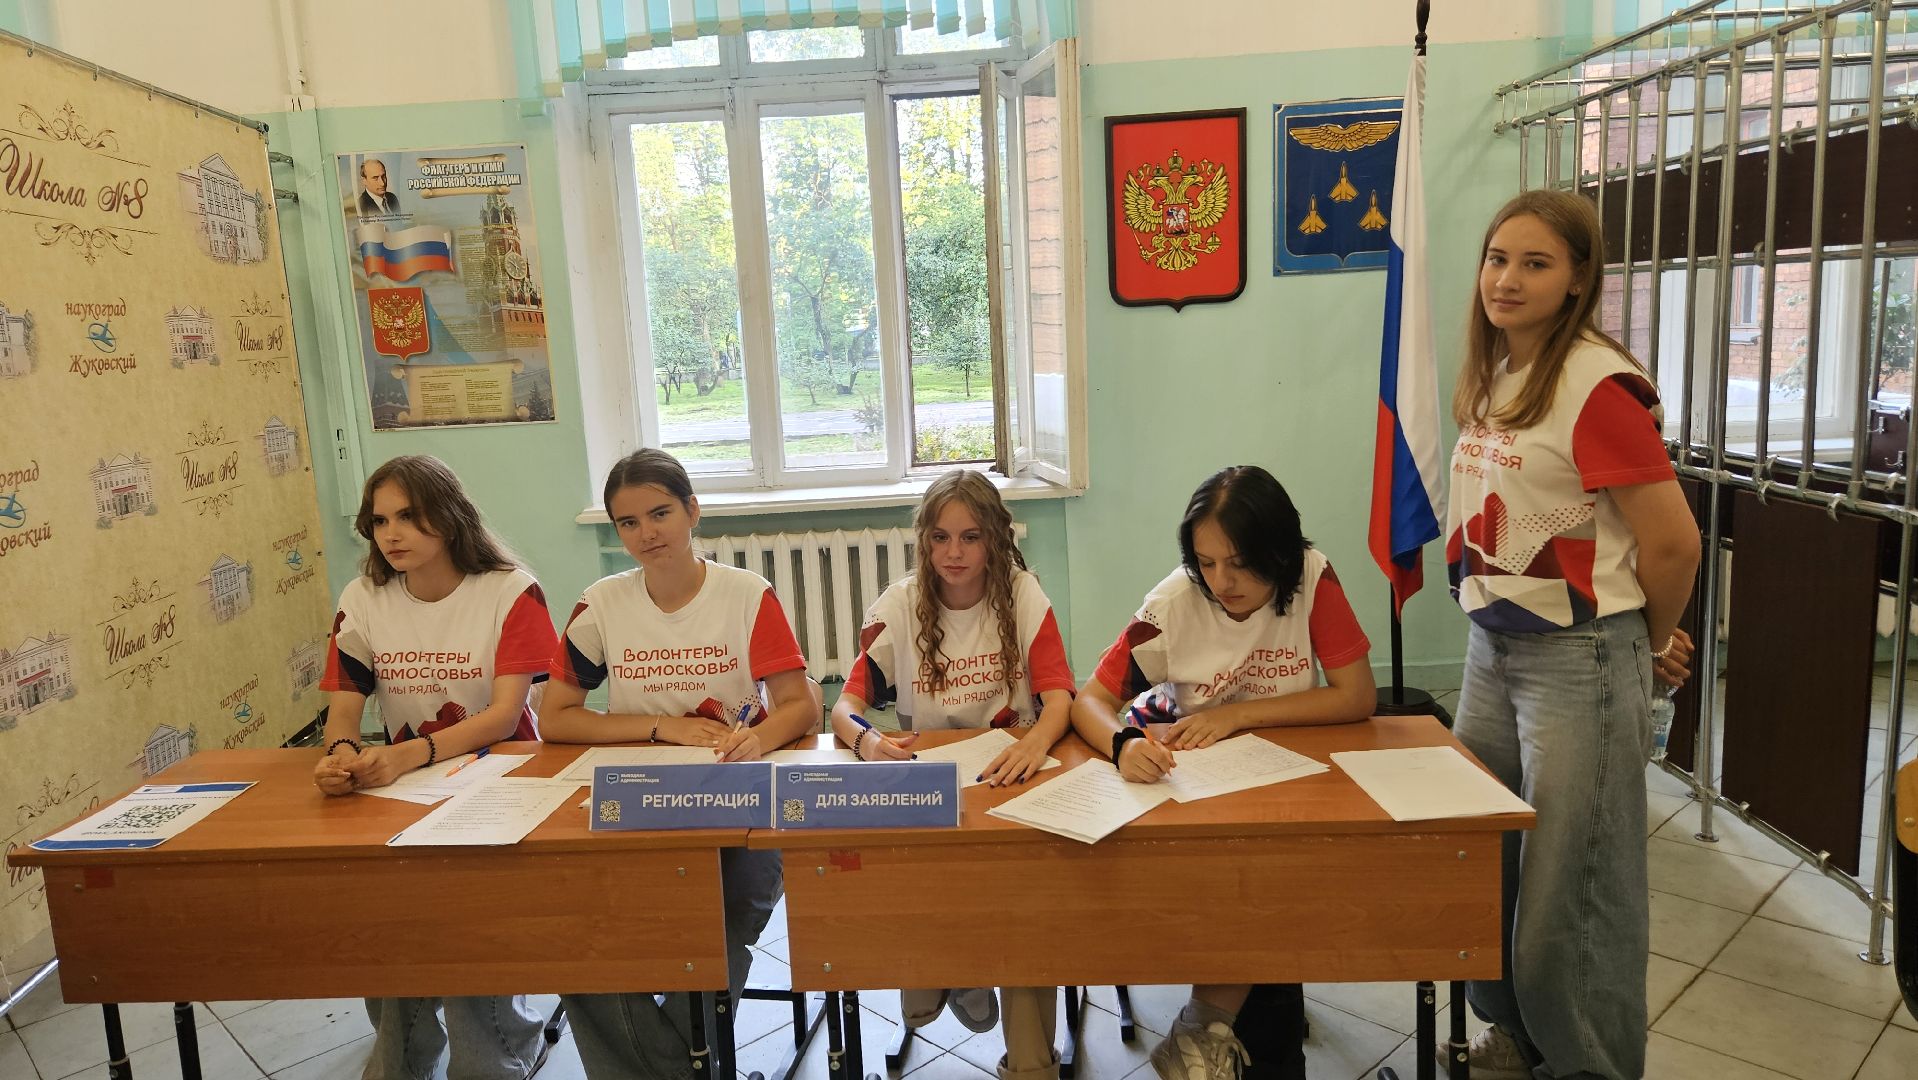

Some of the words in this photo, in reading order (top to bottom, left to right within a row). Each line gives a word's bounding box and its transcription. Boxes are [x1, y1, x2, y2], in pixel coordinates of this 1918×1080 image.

[0, 138, 87, 207] Школа
[449, 163, 470, 175] ГЕРБ
[480, 162, 504, 173] ГИМН
[408, 176, 466, 190] РОССИЙСКОЙ
[466, 174, 521, 187] ФЕДЕРАЦИИ
[65, 297, 126, 322] наукоград
[235, 320, 263, 351] Школа
[69, 353, 136, 378] Жуковский
[0, 460, 39, 492] оград
[181, 456, 214, 491] Школа
[0, 520, 52, 556] овский
[103, 625, 146, 665] Школа
[624, 644, 727, 662] ВОЛОНТЕРЫ
[374, 667, 482, 680] ДМОСОВЬЯ
[613, 657, 738, 680] ПОДМОСКОВЬЯ
[220, 673, 259, 710] наукоград
[388, 685, 406, 695] МЫ
[643, 683, 664, 693] МЫ
[666, 681, 706, 692] РЯДОМ
[912, 668, 1026, 695] ПОДМОСКОЬ
[942, 696, 961, 707] МЫ
[964, 687, 1004, 703] РЯДОМ
[224, 712, 265, 750] Жуковский
[642, 793, 760, 809] РЕГИСТРАЦИЯ
[815, 793, 847, 808] ДЛЯ
[850, 790, 943, 806] ЗАЯВЛЕНИЙ
